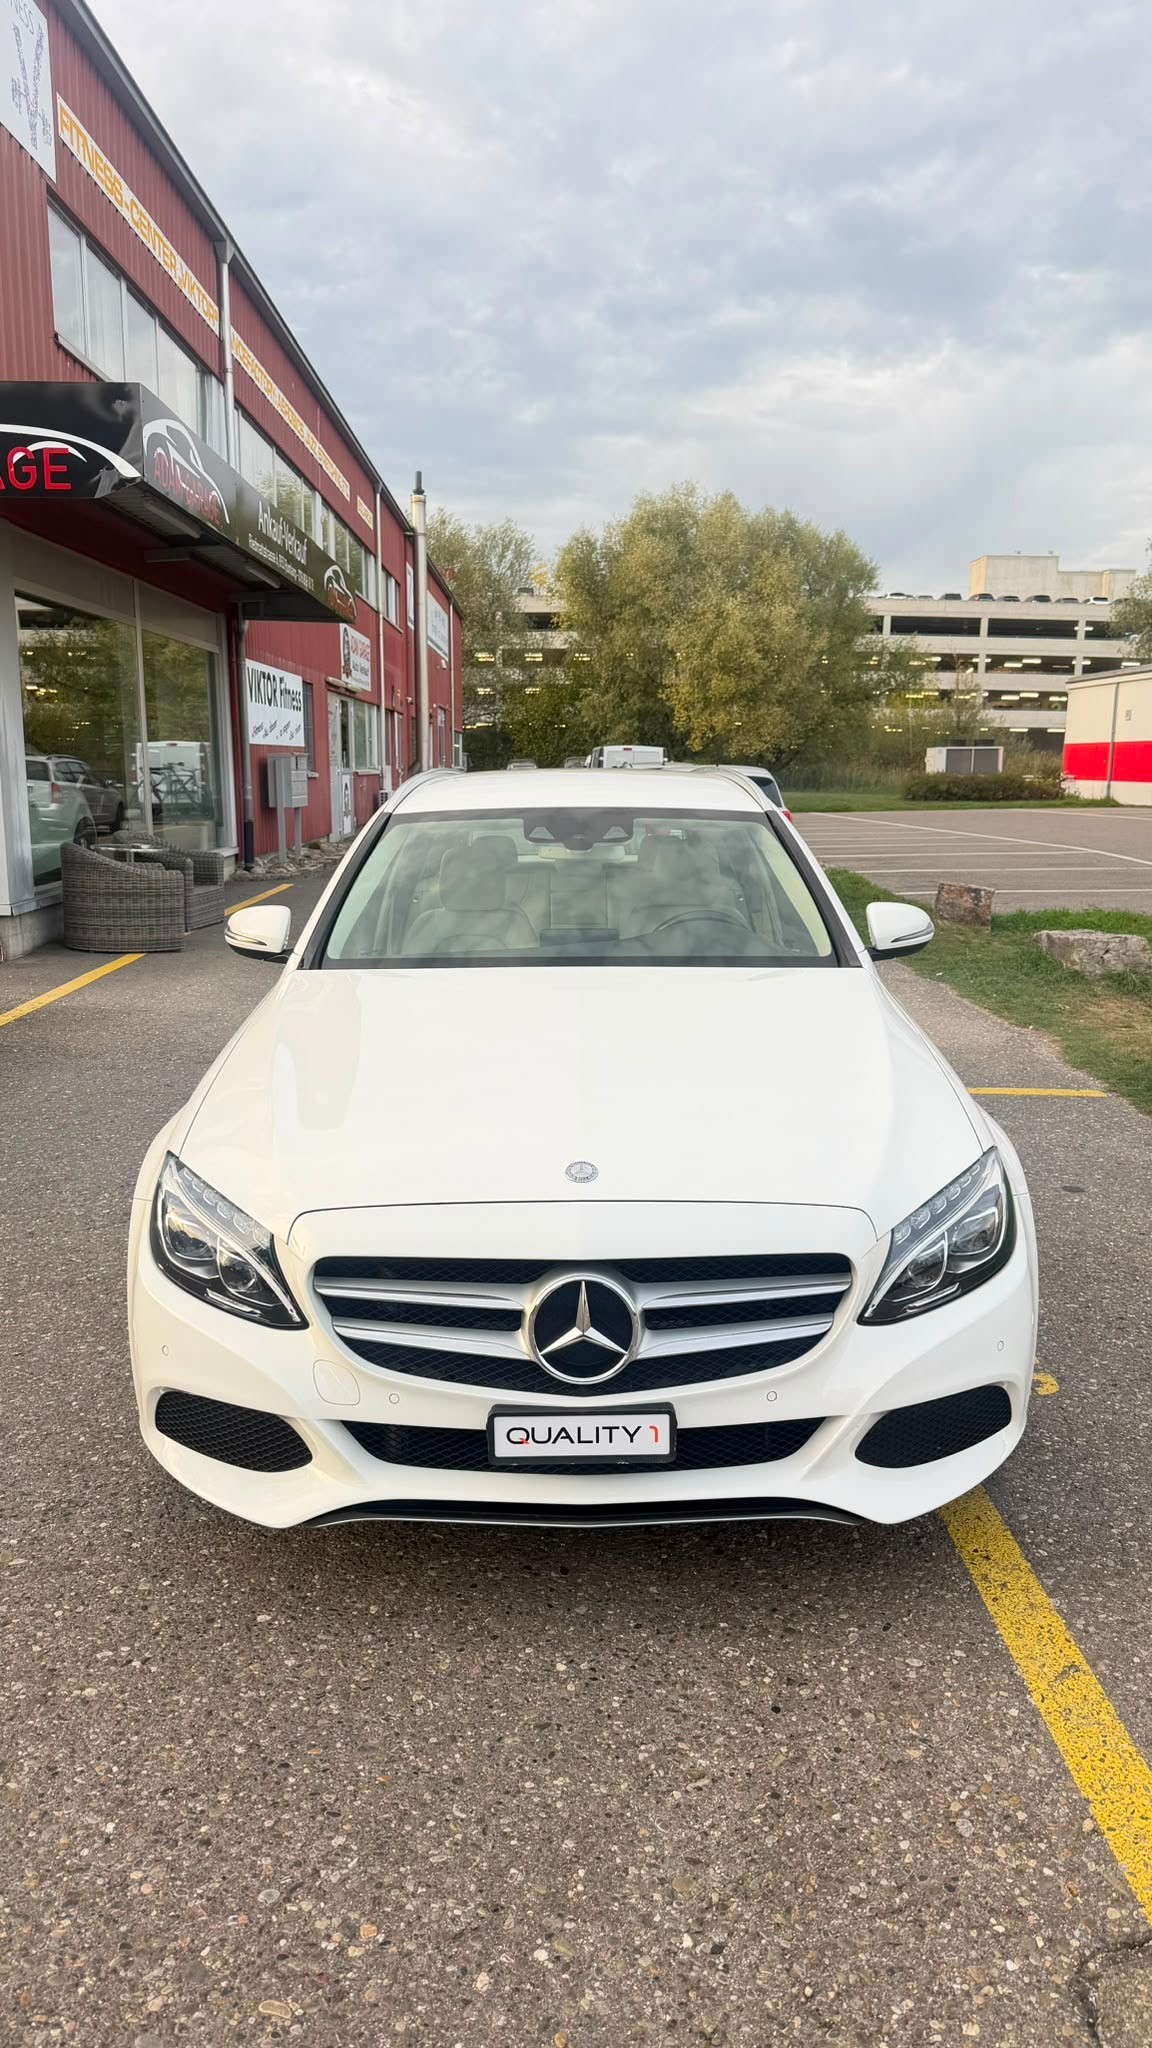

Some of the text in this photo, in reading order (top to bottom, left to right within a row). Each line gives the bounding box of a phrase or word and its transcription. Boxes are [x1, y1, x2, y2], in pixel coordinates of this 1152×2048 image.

[0, 446, 72, 490] GE
[246, 666, 302, 713] VIKTOR Fitness
[506, 1425, 642, 1445] QUALITY
